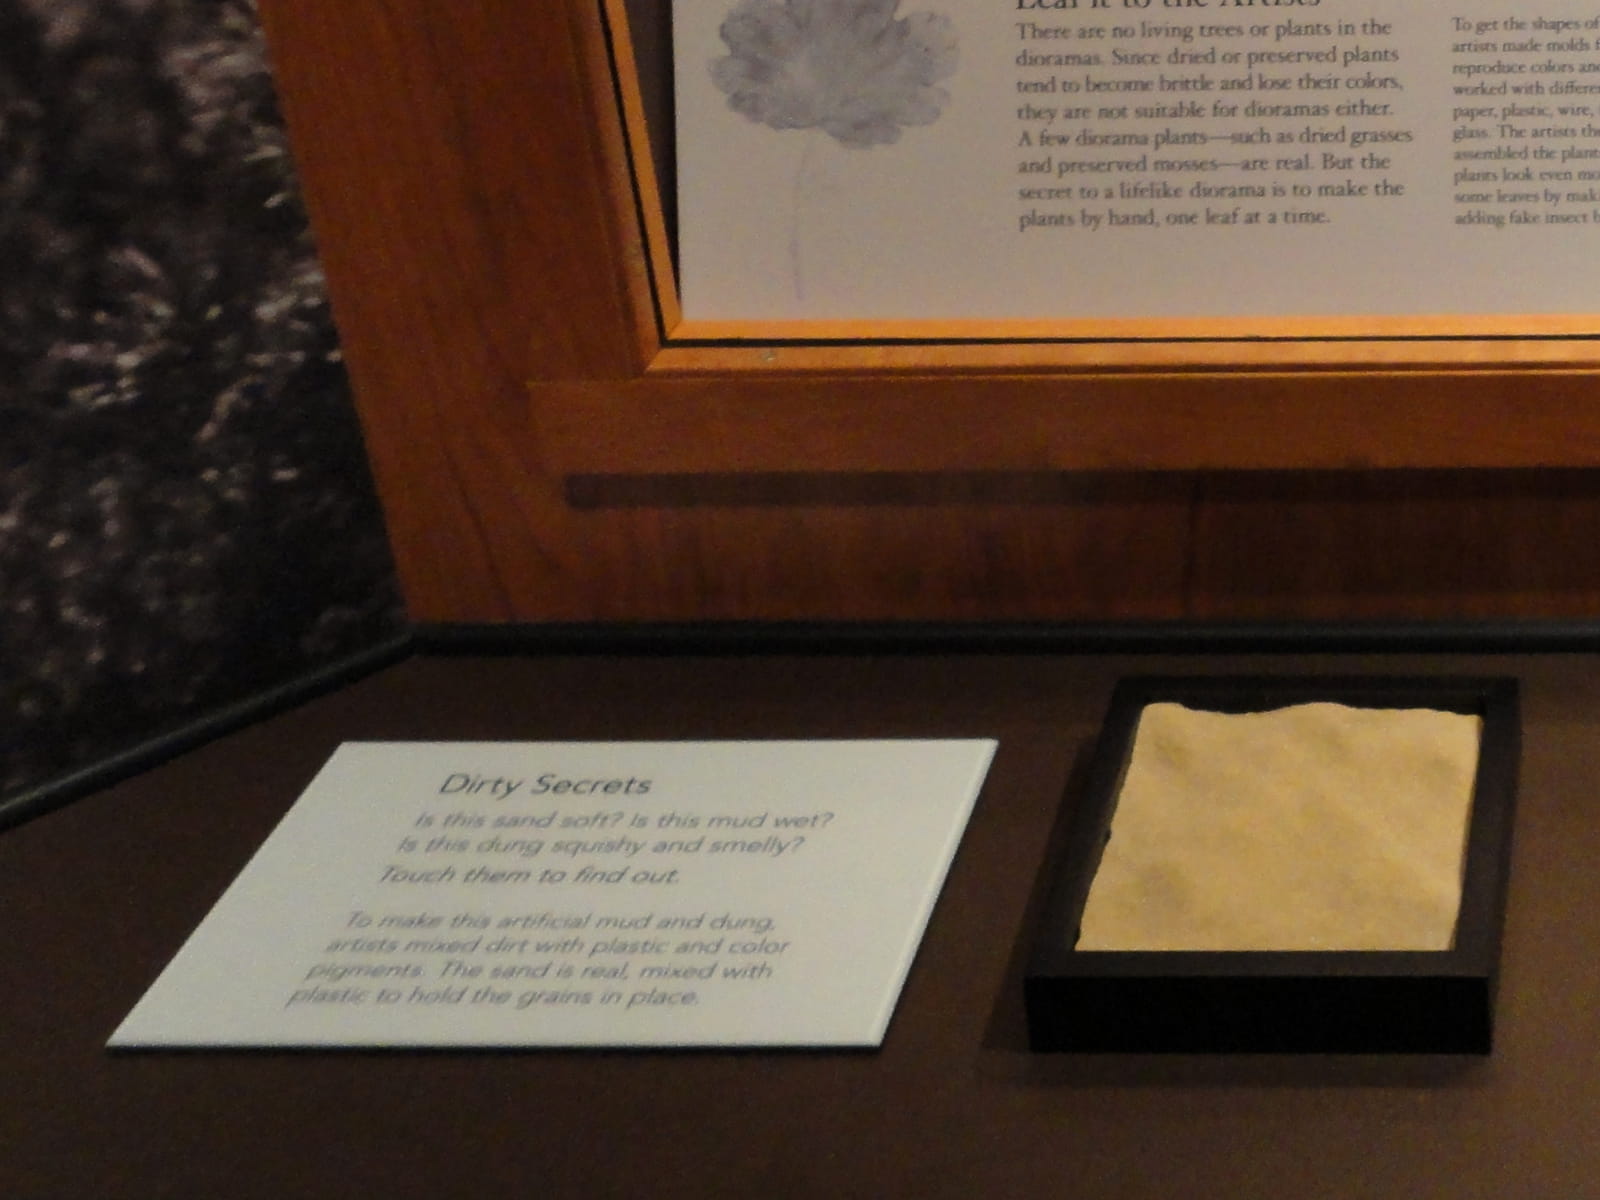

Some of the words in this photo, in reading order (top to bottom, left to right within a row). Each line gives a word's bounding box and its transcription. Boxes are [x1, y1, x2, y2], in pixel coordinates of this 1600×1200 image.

[1017, 21, 1070, 40] There
[1077, 26, 1105, 39] are
[1111, 26, 1135, 39] no
[1139, 19, 1193, 43] living
[1198, 21, 1243, 38] trees
[1249, 24, 1268, 37] or
[1274, 18, 1331, 42] plants
[1337, 17, 1355, 36] in
[1361, 17, 1391, 36] the
[1454, 16, 1472, 31] To
[1475, 16, 1498, 35] get
[1502, 16, 1526, 31] the
[1531, 15, 1580, 34] shapes
[1583, 15, 1599, 30] of
[1451, 37, 1497, 52] artists
[1502, 37, 1541, 52] made
[1546, 37, 1590, 52] molds
[1111, 46, 1160, 65] Since
[1166, 46, 1217, 65] dried
[1221, 51, 1240, 64] or
[1246, 45, 1337, 69] preserved
[1342, 44, 1398, 68] plants
[1016, 74, 1056, 93] tend
[1061, 77, 1080, 93] to
[1084, 73, 1153, 92] become
[1158, 73, 1213, 92] brittle
[1220, 73, 1253, 91] and
[1257, 72, 1291, 91] lose
[1297, 72, 1338, 91] their
[1017, 101, 1057, 125] they
[1063, 106, 1091, 119] are
[1097, 103, 1127, 119] not
[1134, 99, 1205, 118] suitable
[1212, 99, 1237, 118] for
[1244, 98, 1329, 117] dioramas
[1019, 128, 1032, 146] A
[1038, 127, 1069, 146] few
[1075, 126, 1149, 146] diorama
[1276, 131, 1294, 144] as
[1298, 125, 1346, 144] dried
[1350, 130, 1412, 148] grasses
[1017, 154, 1052, 173] and
[1057, 153, 1147, 178] preserved
[1321, 151, 1353, 170] But
[1360, 151, 1390, 169] the
[1018, 184, 1072, 200] secret
[1079, 184, 1098, 199] to
[1104, 186, 1113, 199] a
[1119, 180, 1182, 199] lifelike
[1189, 179, 1266, 198] diorama
[1271, 179, 1286, 197] is
[1291, 181, 1311, 197] to
[1317, 178, 1367, 197] make
[1373, 177, 1404, 196] the
[1019, 208, 1075, 232] plants
[1080, 207, 1102, 231] by
[1165, 212, 1197, 225] one
[1204, 206, 1238, 225] leaf
[1244, 209, 1260, 224] at
[1267, 211, 1277, 224] a
[1454, 209, 1505, 228] adding
[1509, 209, 1540, 224] fake
[1544, 208, 1588, 224] insect
[439, 774, 521, 800] Dirty
[533, 774, 650, 794] Secrets
[414, 812, 434, 829] Is
[442, 812, 484, 829] this
[492, 812, 557, 828] sand
[560, 812, 624, 828] soft?
[629, 812, 648, 828] Is
[657, 811, 700, 828] this
[707, 811, 768, 828] mud
[773, 811, 834, 828] wet?
[397, 836, 418, 853] Is
[424, 836, 469, 853] this
[476, 836, 544, 858] dung
[552, 836, 644, 858] squishy
[652, 836, 705, 853] and
[709, 836, 804, 858] smelly?
[381, 867, 455, 883] Touch
[463, 867, 530, 883] them
[538, 869, 566, 883] to
[573, 867, 629, 883] find
[347, 912, 372, 929] To
[378, 912, 442, 929] make
[449, 912, 490, 929] this
[497, 912, 591, 929] artificial
[595, 913, 653, 929] mud
[656, 913, 705, 930] and
[325, 937, 397, 954] artists
[404, 937, 482, 954] mixed
[485, 937, 528, 954] dirt
[535, 937, 584, 954] with
[588, 937, 665, 958] plastic
[674, 937, 724, 954] and
[728, 937, 789, 954] color
[440, 962, 483, 979] The
[490, 962, 552, 979] sand
[555, 962, 574, 979] is
[639, 962, 717, 979] mixed
[722, 962, 772, 979] with
[285, 988, 364, 1009] plastic
[375, 991, 402, 1005] to
[407, 988, 467, 1005] hold
[471, 988, 511, 1005] the
[516, 988, 591, 1009] grains
[599, 988, 622, 1004] in
